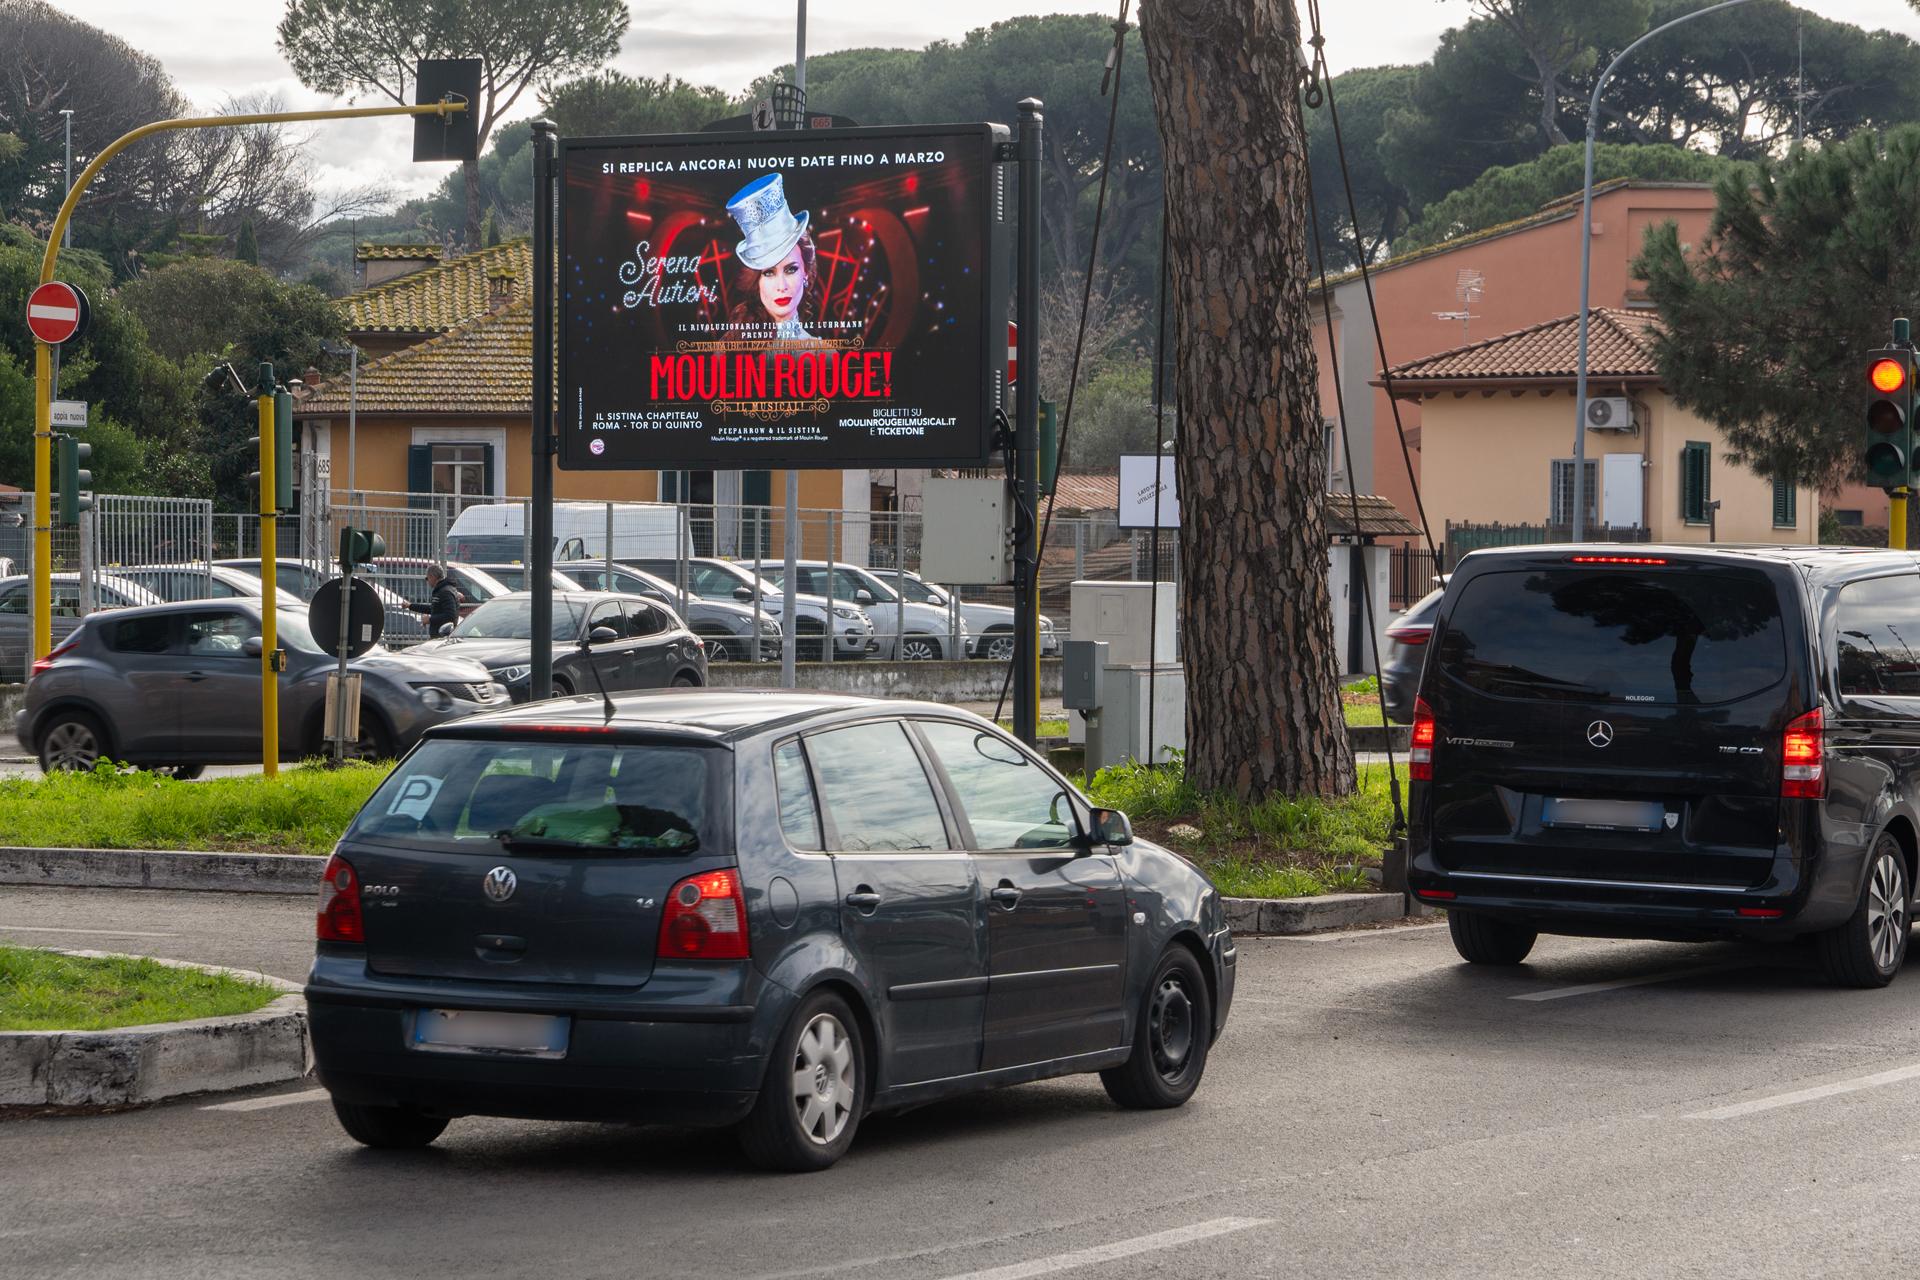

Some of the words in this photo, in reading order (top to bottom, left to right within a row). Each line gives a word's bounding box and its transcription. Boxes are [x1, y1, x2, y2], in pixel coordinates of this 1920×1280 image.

[602, 163, 614, 174] SI
[619, 161, 674, 173] REPLICA
[679, 158, 741, 172] ANCORA!
[747, 156, 795, 169] NUOVE
[801, 155, 835, 167] DATE
[841, 153, 875, 166] FINO
[880, 152, 889, 164] A
[895, 151, 945, 164] MARZO
[619, 240, 702, 285] Serena
[623, 274, 718, 308] Autieri
[678, 324, 687, 332] IL
[690, 322, 760, 331] RIVOLUZIONARIO
[763, 321, 783, 330] FILM
[799, 321, 814, 329] BAZ
[817, 320, 863, 329] LUHRMANN
[741, 331, 773, 339] PRENDE
[651, 354, 767, 400] MOULIN
[774, 351, 893, 400] ROUGE!
[736, 402, 747, 411] IL
[751, 401, 804, 411] MUSICAL!
[69, 413, 85, 421] nuova
[607, 412, 643, 420] SISTINA
[646, 411, 699, 420] CHAPITEAU
[872, 408, 909, 417] BIGLIETTI
[911, 408, 922, 417] SU
[592, 421, 620, 430] ROMA
[630, 421, 649, 430] TOR
[652, 421, 662, 429] DI
[665, 420, 703, 430] QUINTO
[839, 417, 957, 427] MOULINROUGEILMUSICAL.IT
[718, 427, 766, 435] PEEPARROW
[788, 426, 821, 434] SISTINA
[870, 428, 876, 436] E
[877, 427, 925, 436] TICKETONE
[318, 459, 330, 474] 685
[1446, 736, 1474, 746] VITO
[392, 779, 433, 814] P
[364, 885, 399, 896] POLO
